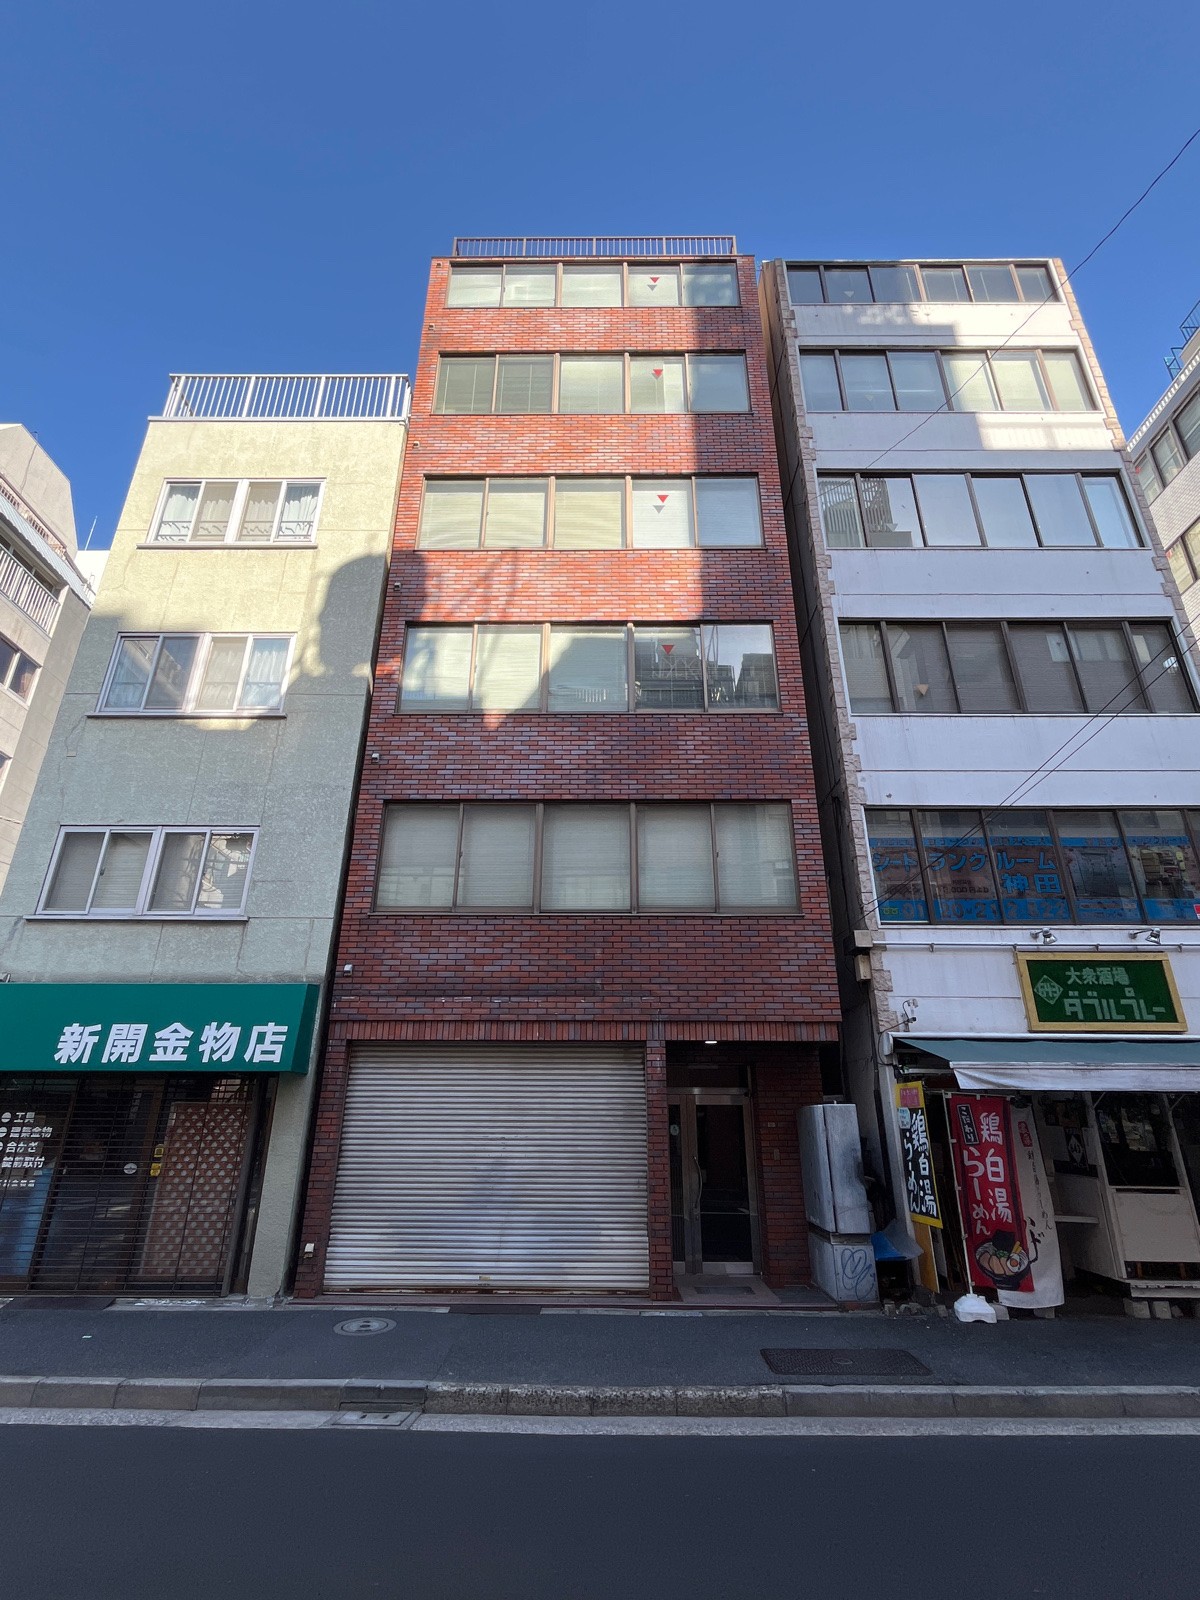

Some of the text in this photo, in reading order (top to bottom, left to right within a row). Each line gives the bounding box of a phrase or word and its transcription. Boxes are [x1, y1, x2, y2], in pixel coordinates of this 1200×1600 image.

[1001, 873, 1062, 895] 神田
[1065, 966, 1130, 986] 大衆酒場
[54, 1022, 289, 1064] 新開金物店
[9, 1126, 53, 1138] 建築金物
[13, 1111, 36, 1123] 工具
[903, 1130, 921, 1214] らーめん
[980, 1111, 1013, 1224] 鶏白湯
[962, 1146, 991, 1236] らーめん
